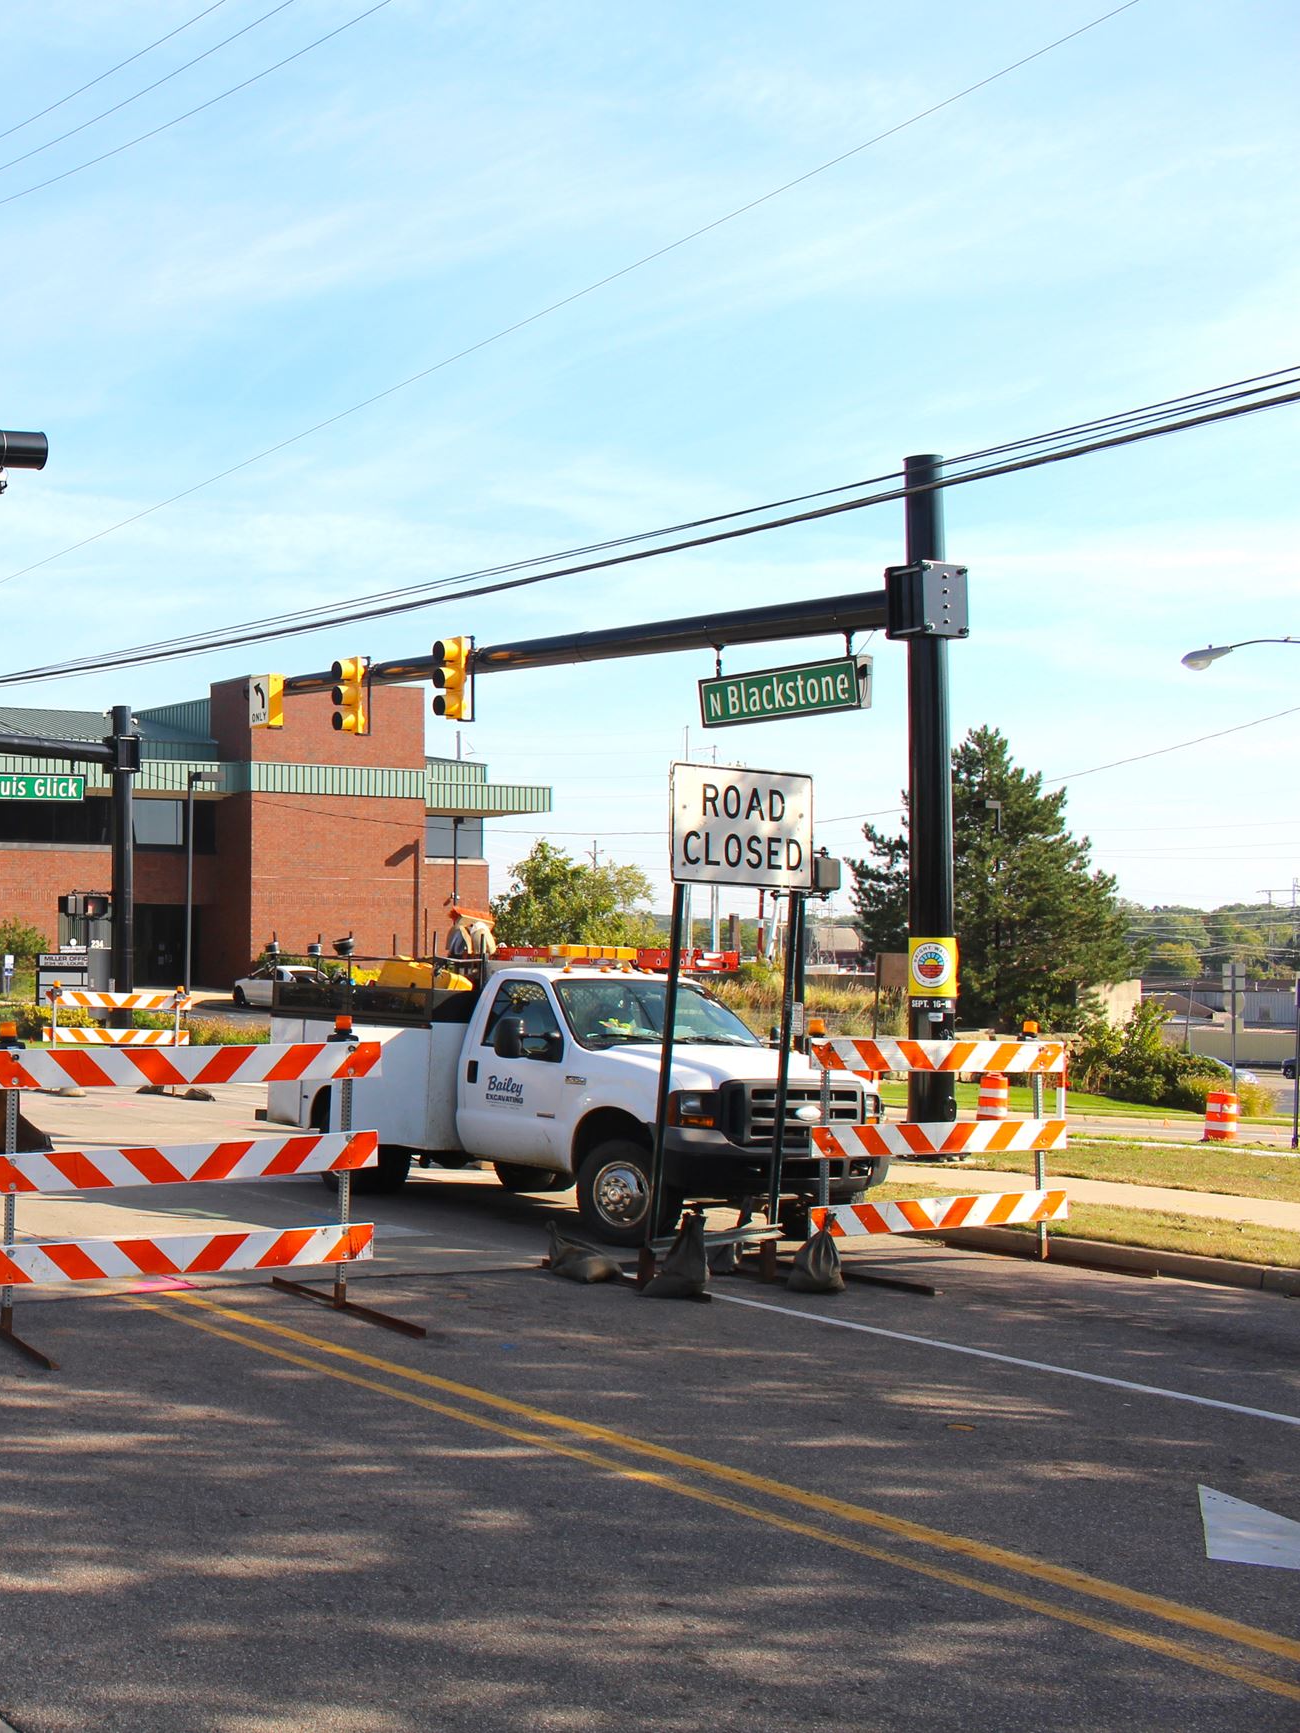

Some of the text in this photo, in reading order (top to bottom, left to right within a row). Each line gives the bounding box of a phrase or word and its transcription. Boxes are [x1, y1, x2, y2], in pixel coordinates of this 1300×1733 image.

[709, 672, 849, 717] N Blackstone
[251, 711, 267, 723] ONLY
[34, 778, 78, 797] Glick
[702, 783, 785, 822] ROAD
[683, 830, 803, 871] CLOSED
[91, 939, 104, 949] 234
[911, 999, 930, 1008] SEPT.
[488, 1075, 524, 1097] Bailey
[485, 1093, 524, 1104] EXCAVATING
